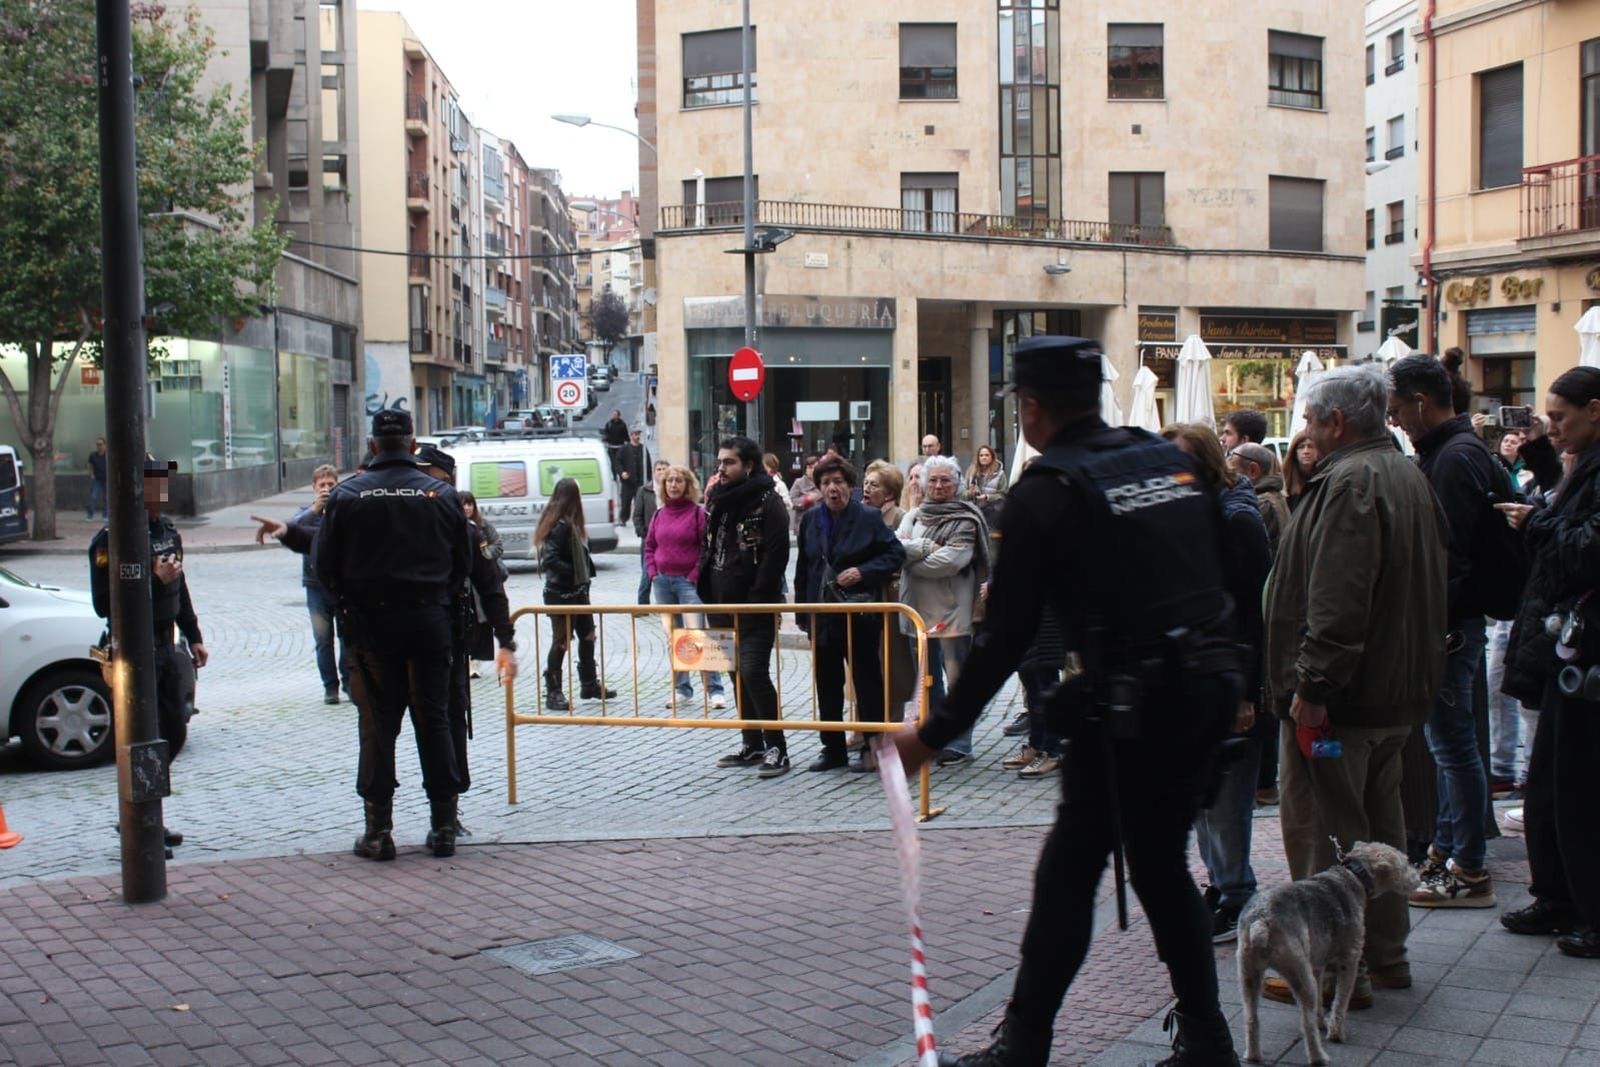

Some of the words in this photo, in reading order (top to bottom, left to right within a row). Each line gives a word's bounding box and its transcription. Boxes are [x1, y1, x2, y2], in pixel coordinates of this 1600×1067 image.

[1202, 320, 1233, 336] Santa
[1217, 346, 1243, 359] Santa
[563, 390, 575, 398] 20
[360, 488, 425, 499] POLICIA
[480, 503, 528, 516] Muñoz
